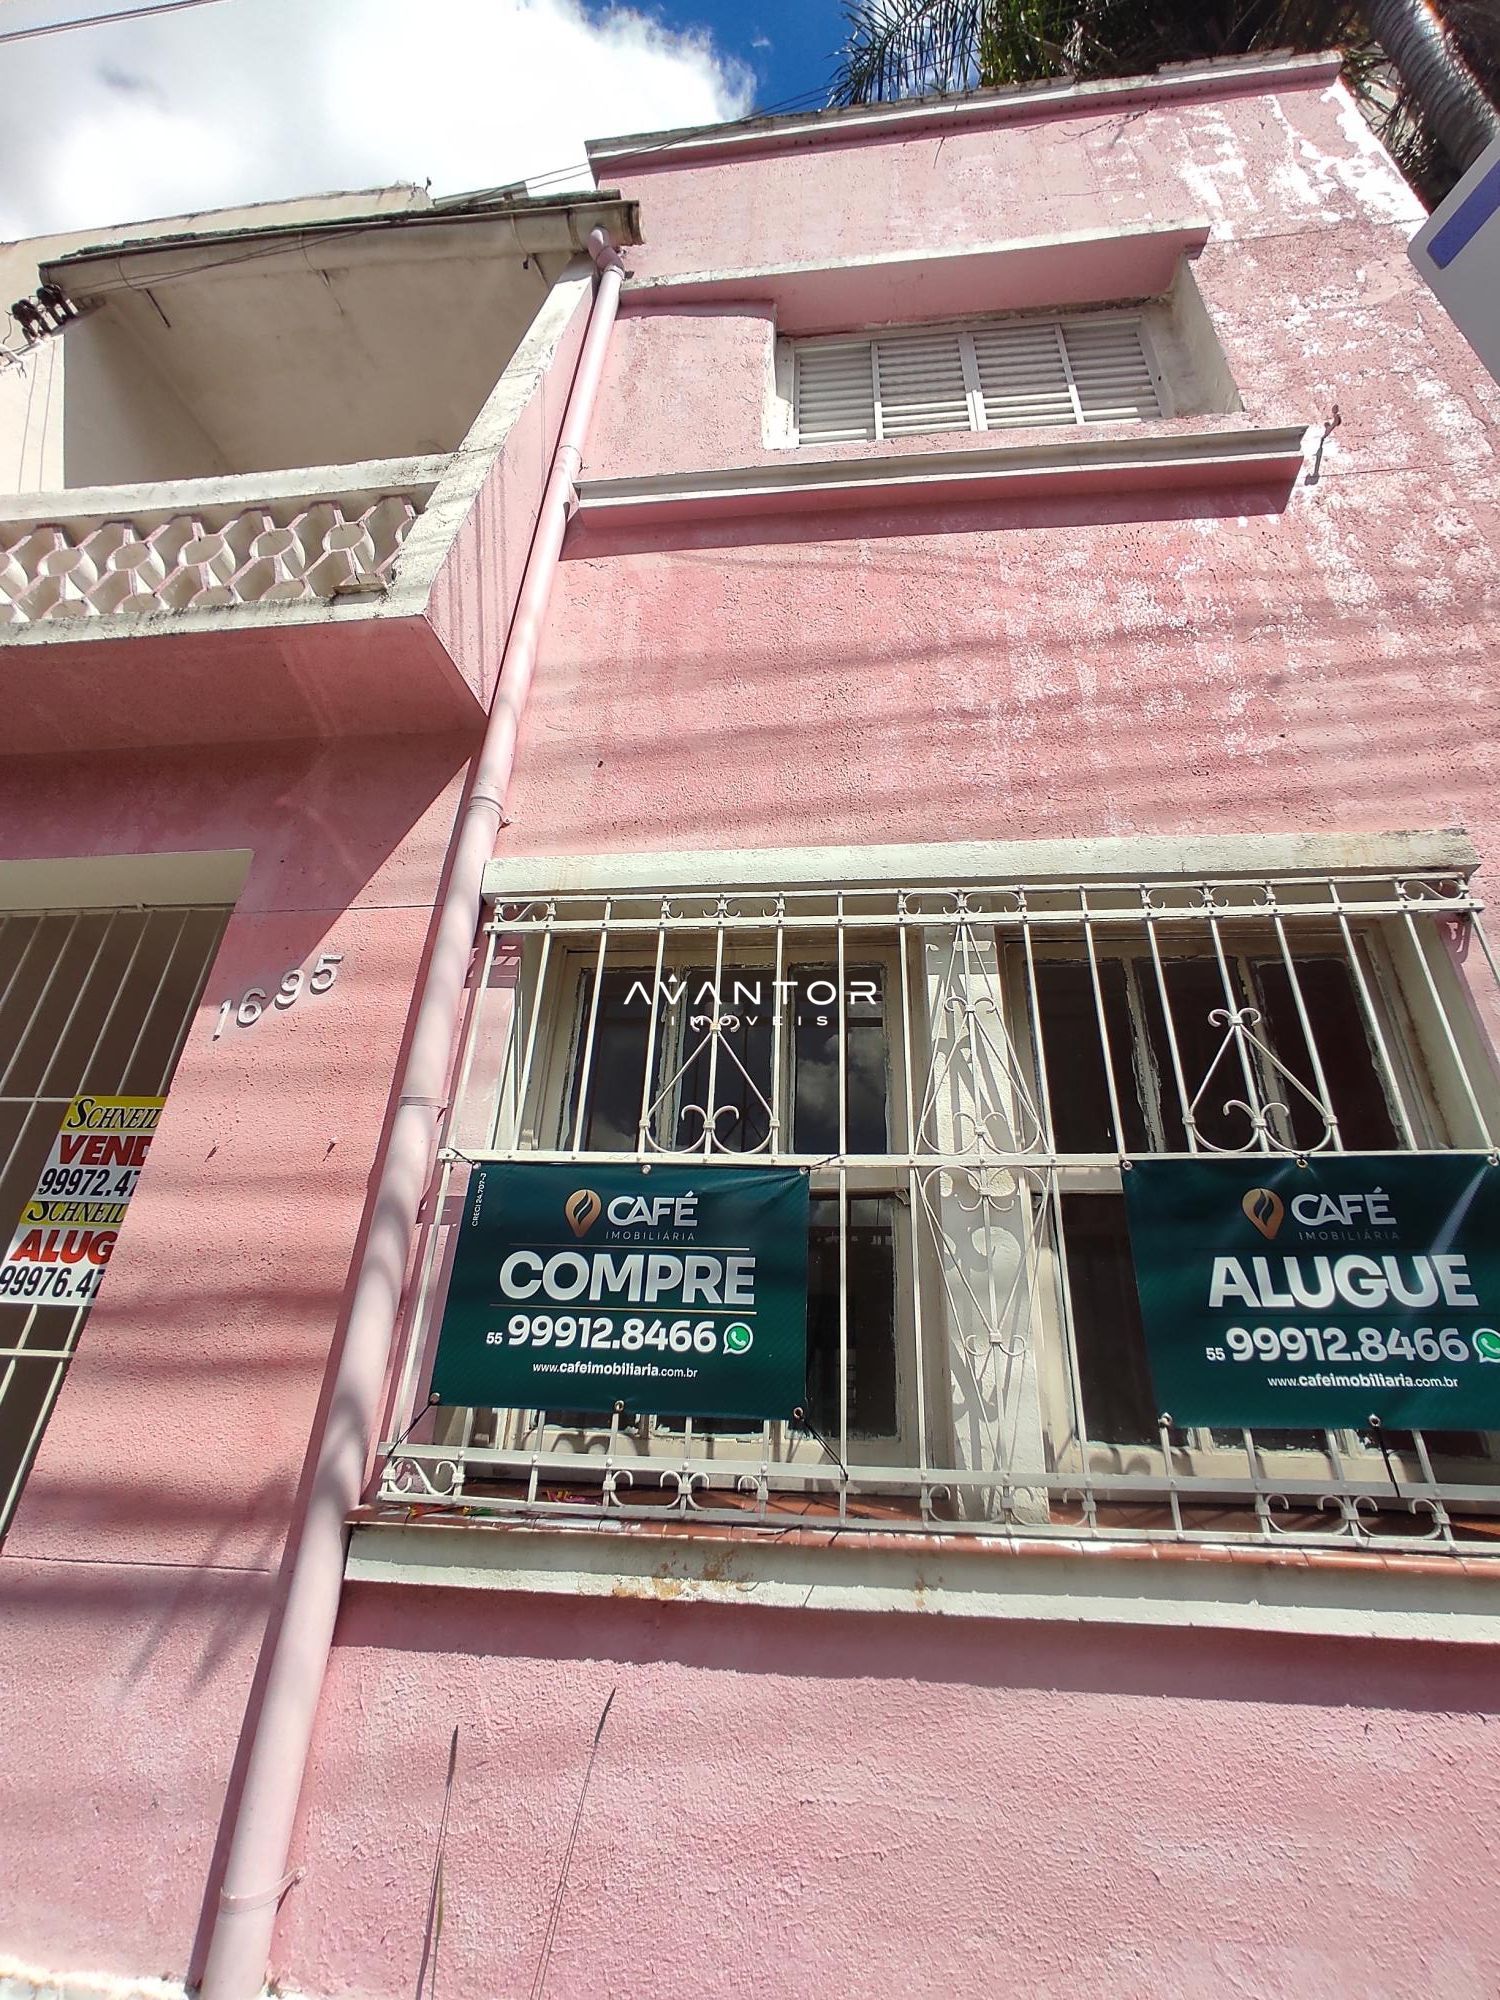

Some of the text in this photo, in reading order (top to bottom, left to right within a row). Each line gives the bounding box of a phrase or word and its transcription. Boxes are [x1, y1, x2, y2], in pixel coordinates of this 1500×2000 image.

[212, 953, 344, 1041] 1695
[471, 1204, 481, 1227] CRECI
[607, 1190, 698, 1227] CAFÉ
[1291, 1187, 1397, 1226] CAFÉ
[9, 1229, 118, 1265] ALUG
[499, 1250, 756, 1305] COMPRE
[1208, 1254, 1480, 1309] ALUGUE
[486, 1314, 717, 1351] 55 99912.8466
[1206, 1327, 1470, 1363] 55 99912.8466
[532, 1361, 698, 1378] www.cafeimobiliaria.com.br
[1268, 1372, 1459, 1388] www.cafeimobiliaria.com.br
